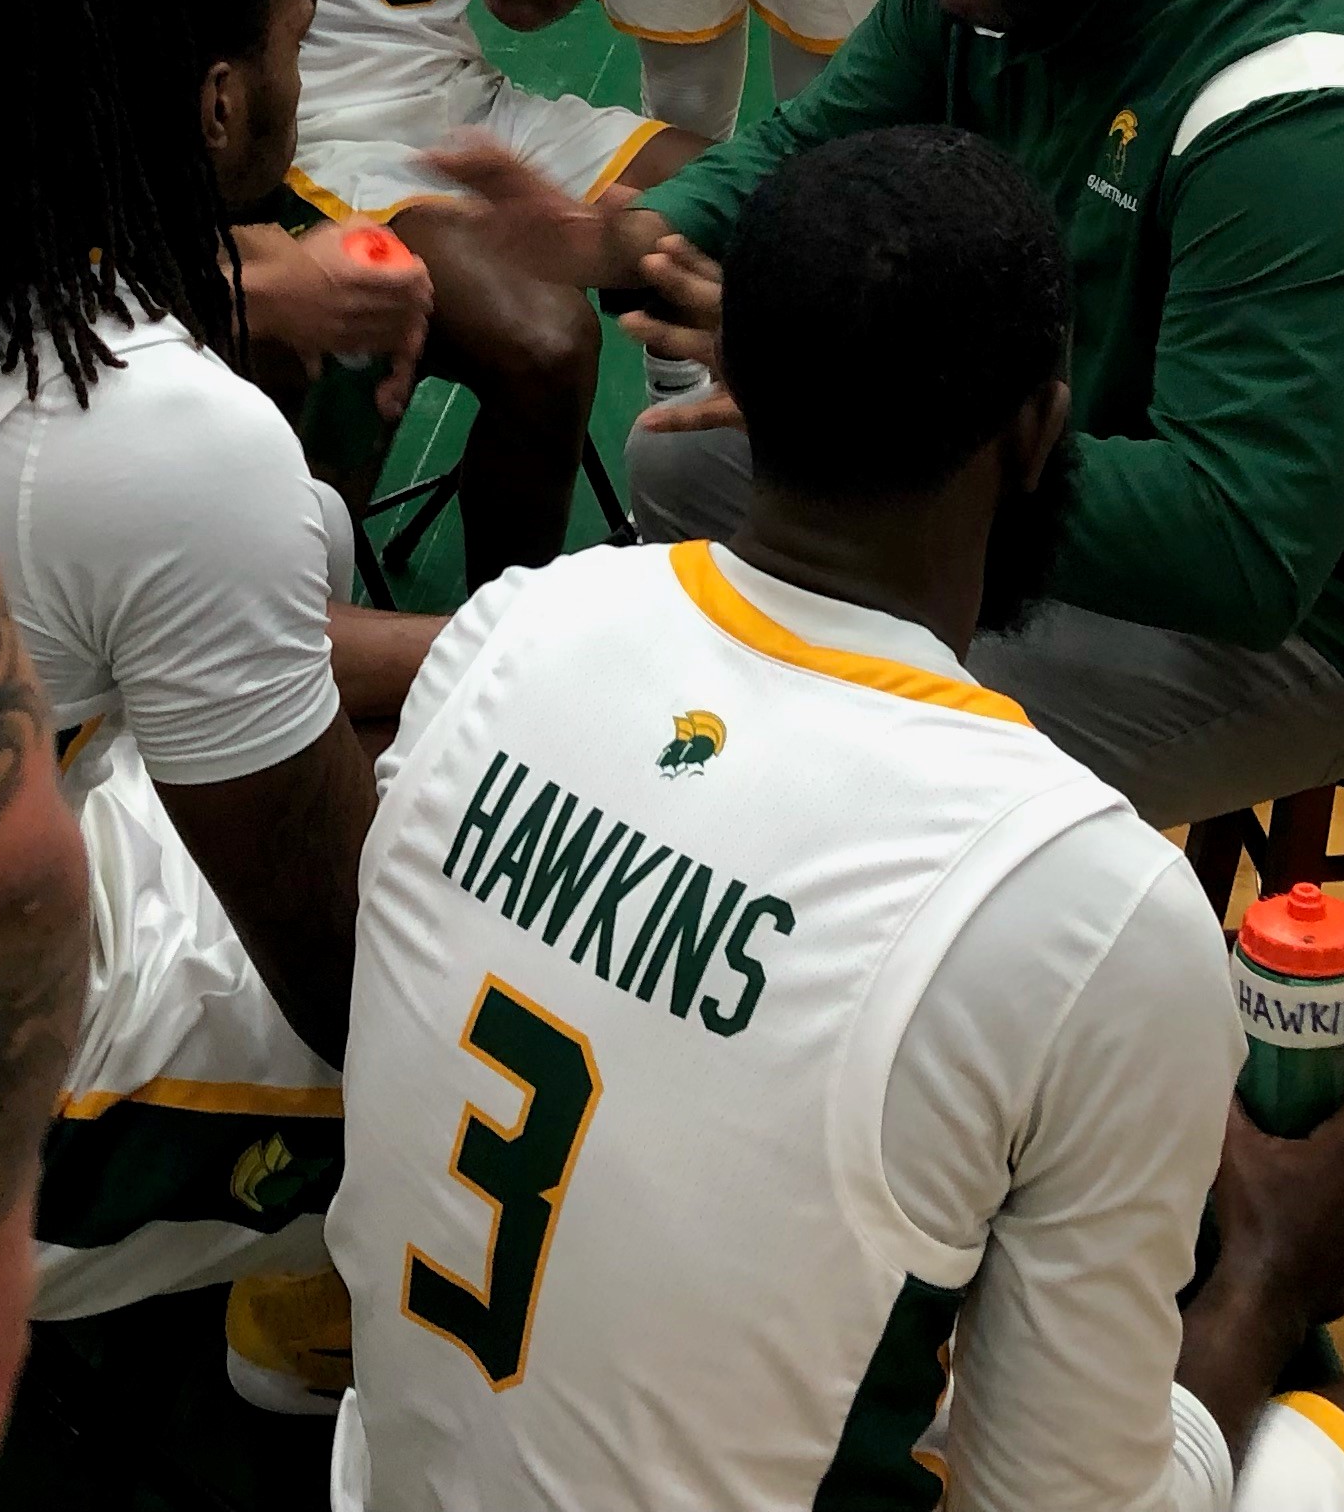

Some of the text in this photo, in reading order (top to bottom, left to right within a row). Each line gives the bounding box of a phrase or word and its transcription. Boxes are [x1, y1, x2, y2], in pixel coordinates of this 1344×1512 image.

[1086, 174, 1137, 212] BASKETBALL
[441, 749, 796, 1038] HAWKINS
[400, 970, 604, 1394] 3
